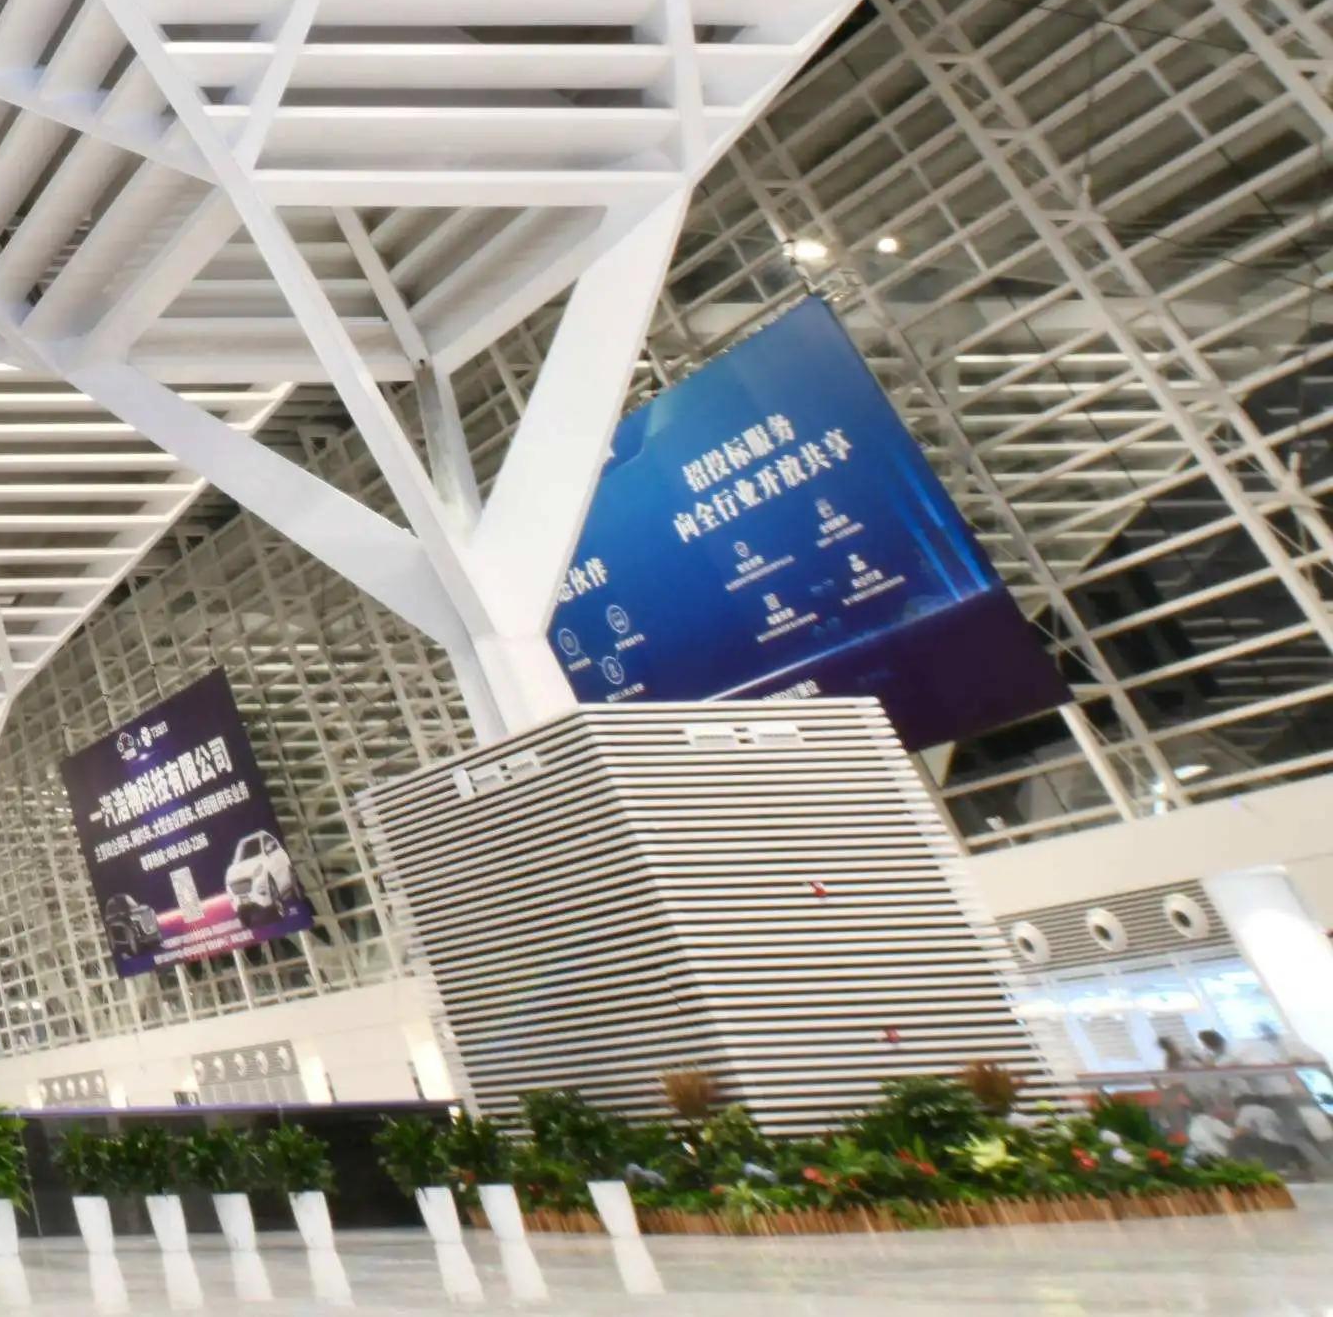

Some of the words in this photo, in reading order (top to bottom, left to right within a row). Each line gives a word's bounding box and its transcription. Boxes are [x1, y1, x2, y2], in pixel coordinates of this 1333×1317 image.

[673, 428, 852, 543] 向全行业开放共享
[682, 413, 795, 492] 招投标服务
